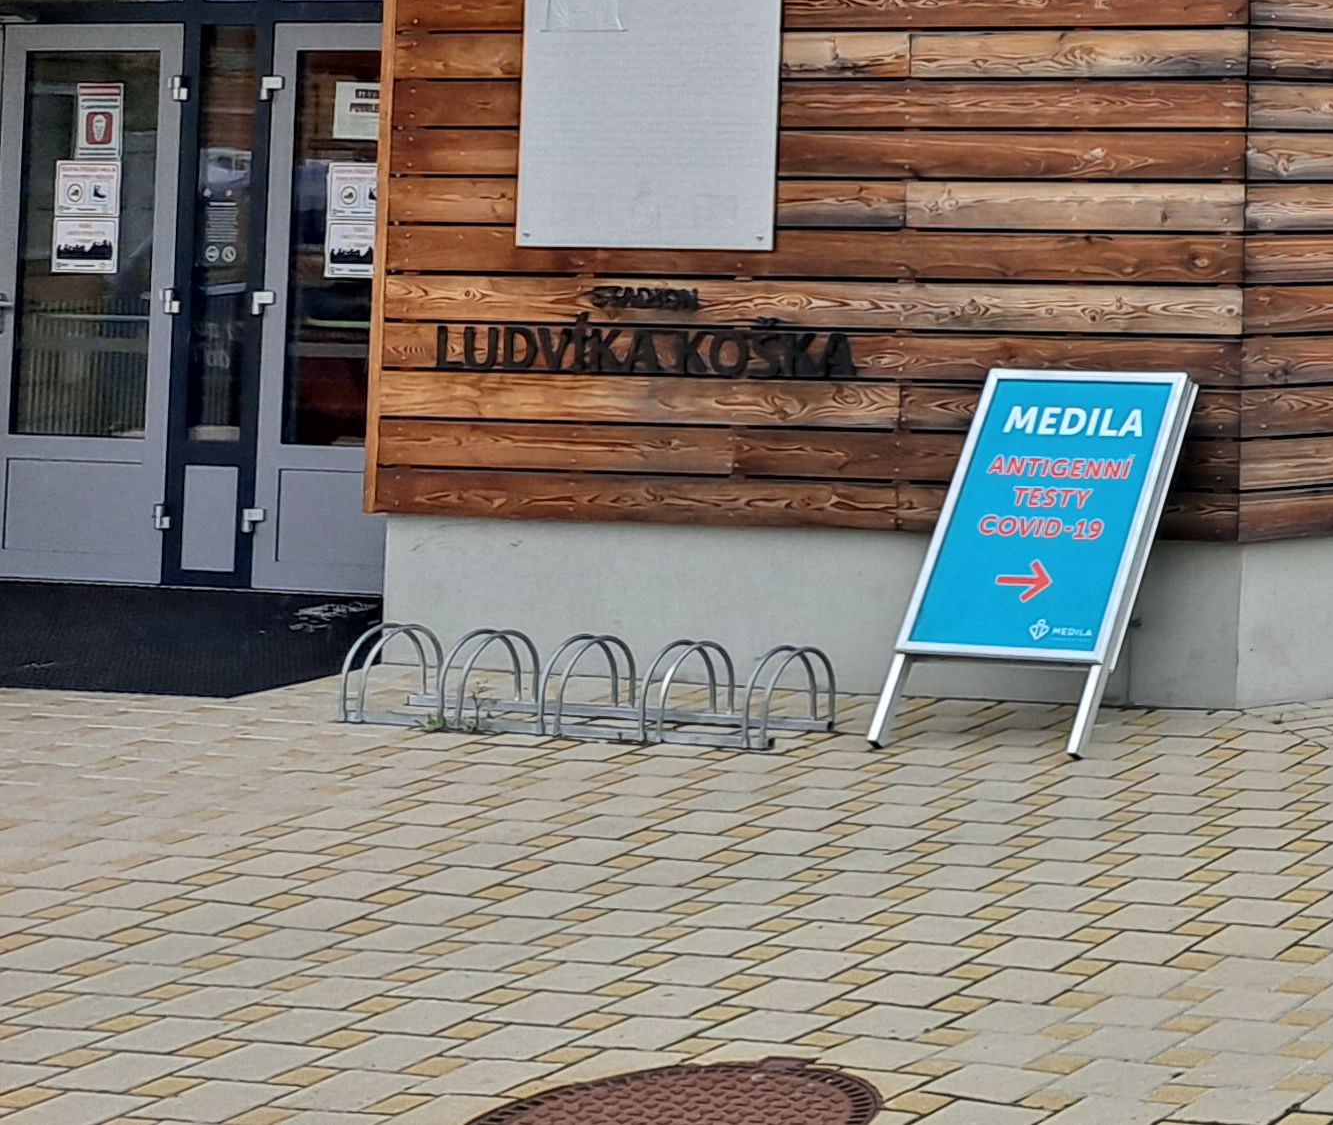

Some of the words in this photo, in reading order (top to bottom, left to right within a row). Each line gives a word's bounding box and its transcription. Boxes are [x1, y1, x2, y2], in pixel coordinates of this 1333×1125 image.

[436, 311, 660, 373] LUDVÍKA
[1002, 405, 1144, 437] MEDILA
[987, 454, 1136, 479] ANTIGENNÍ
[1012, 487, 1093, 509] TESTY
[977, 515, 1105, 540] COVID-19
[1051, 627, 1093, 636] MEDILA
